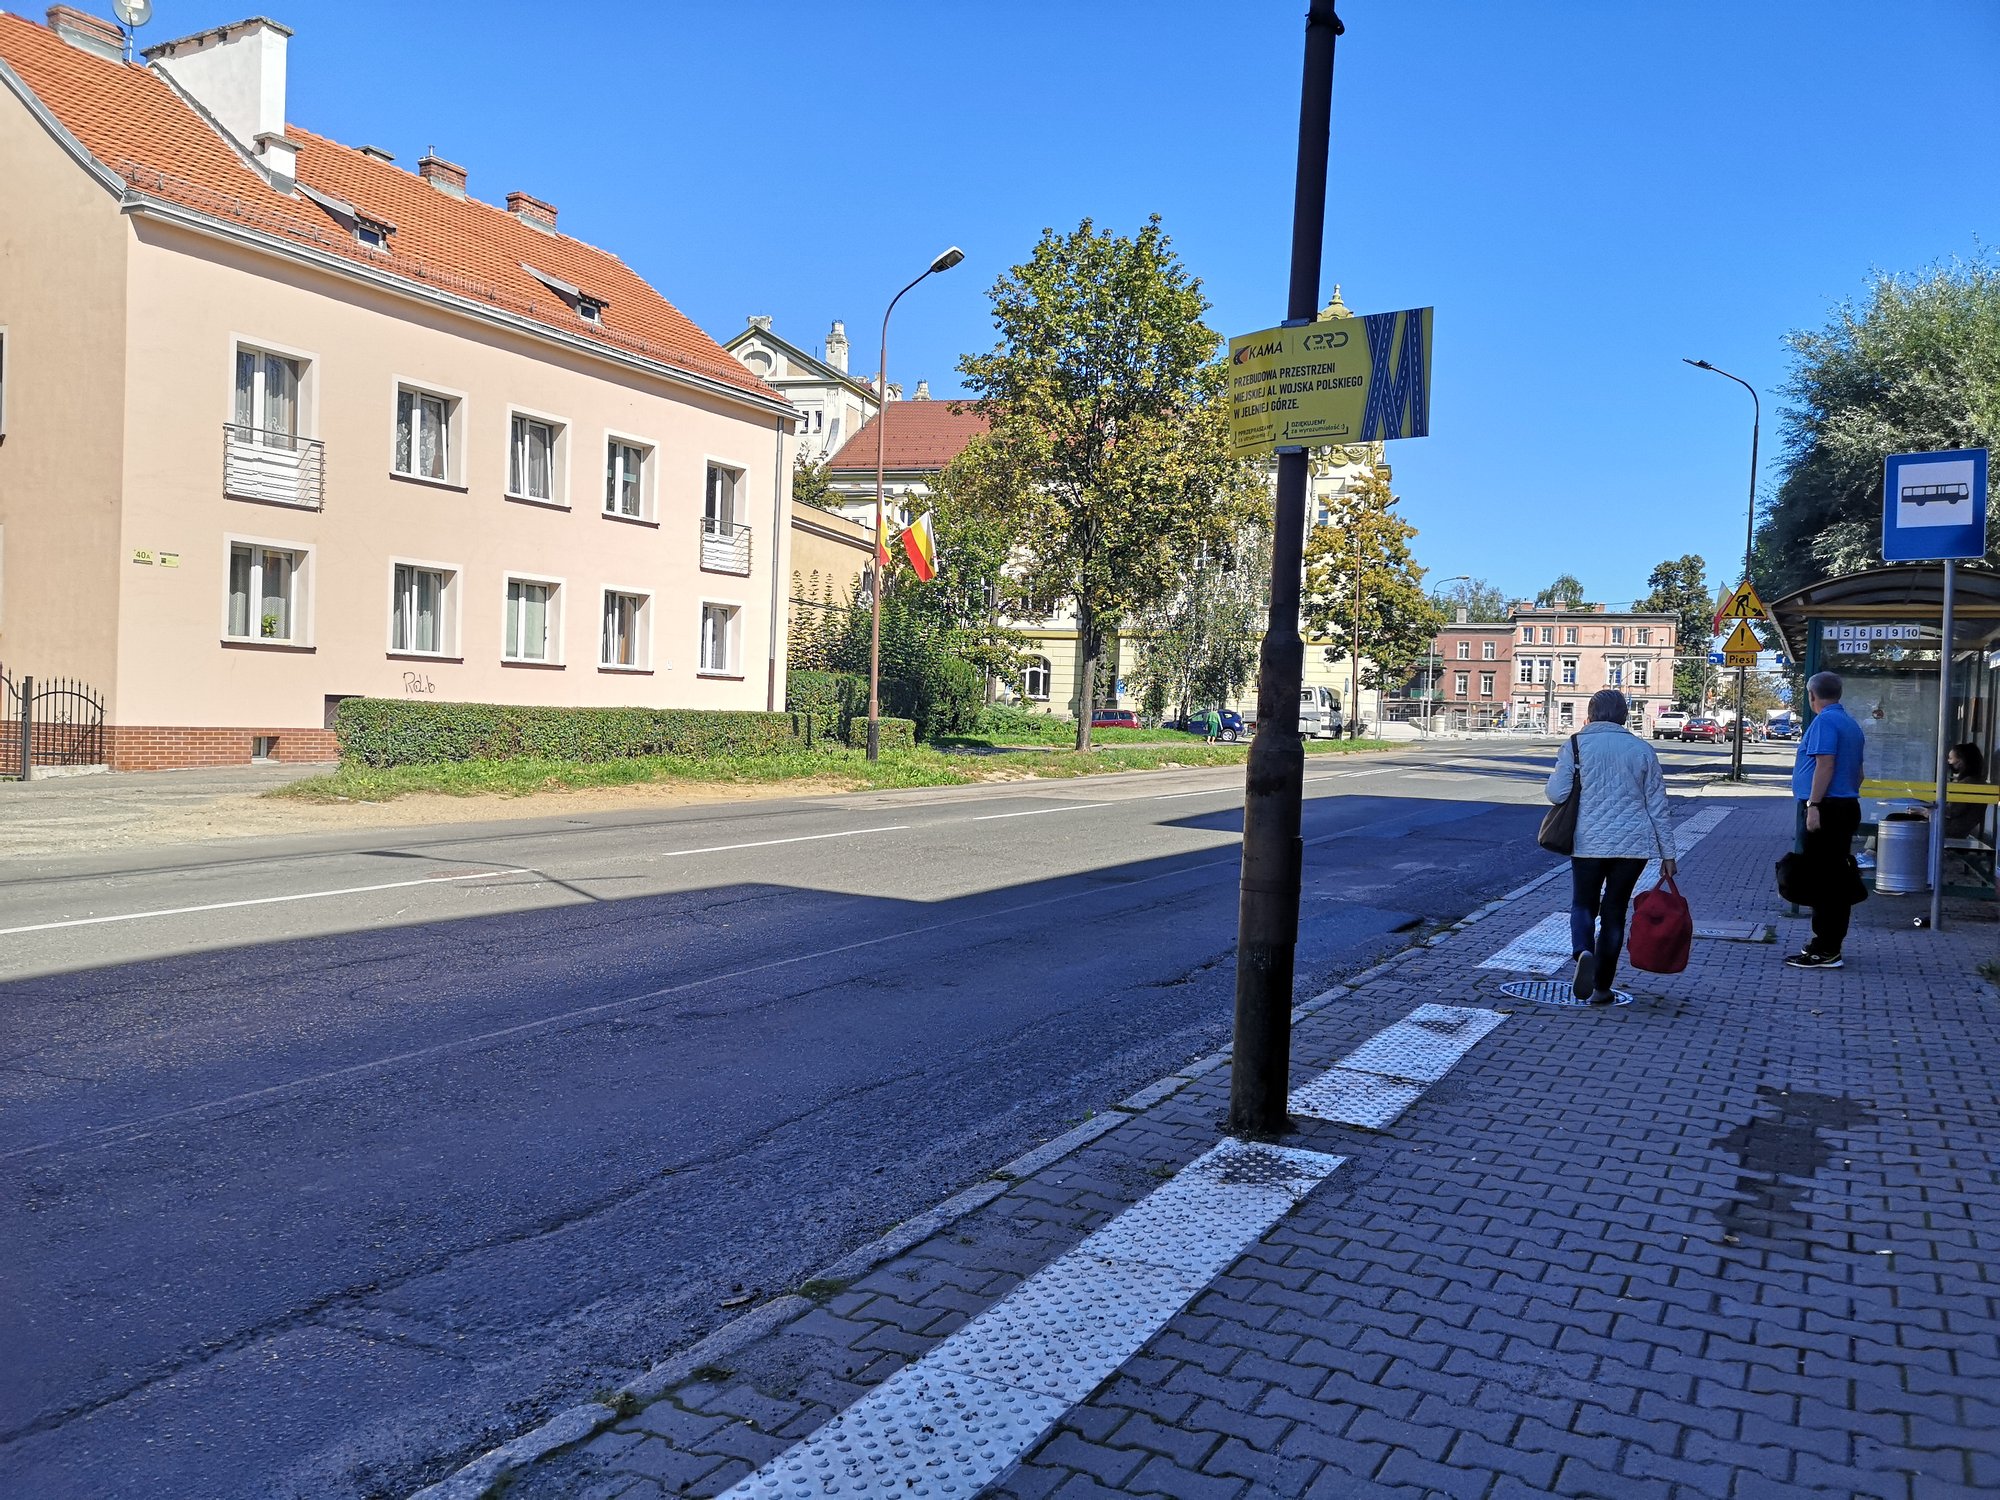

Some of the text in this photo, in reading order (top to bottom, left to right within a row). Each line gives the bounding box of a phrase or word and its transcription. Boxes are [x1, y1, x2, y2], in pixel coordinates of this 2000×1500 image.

[1249, 341, 1283, 359] KAMA
[1234, 362, 1335, 388] PRZEBUDOWA PRZESTRZENI
[1234, 387, 1265, 404] MIEJSKIEJ
[1280, 381, 1314, 395] WOJSKA
[1316, 375, 1363, 391] POLSKIEGO
[1234, 398, 1299, 420] W JELENIEJ GÓRZE.
[1828, 629, 1918, 637] 1 5 6 8 9 10
[1840, 643, 1868, 651] 17 19
[1729, 655, 1754, 664] Piesi
